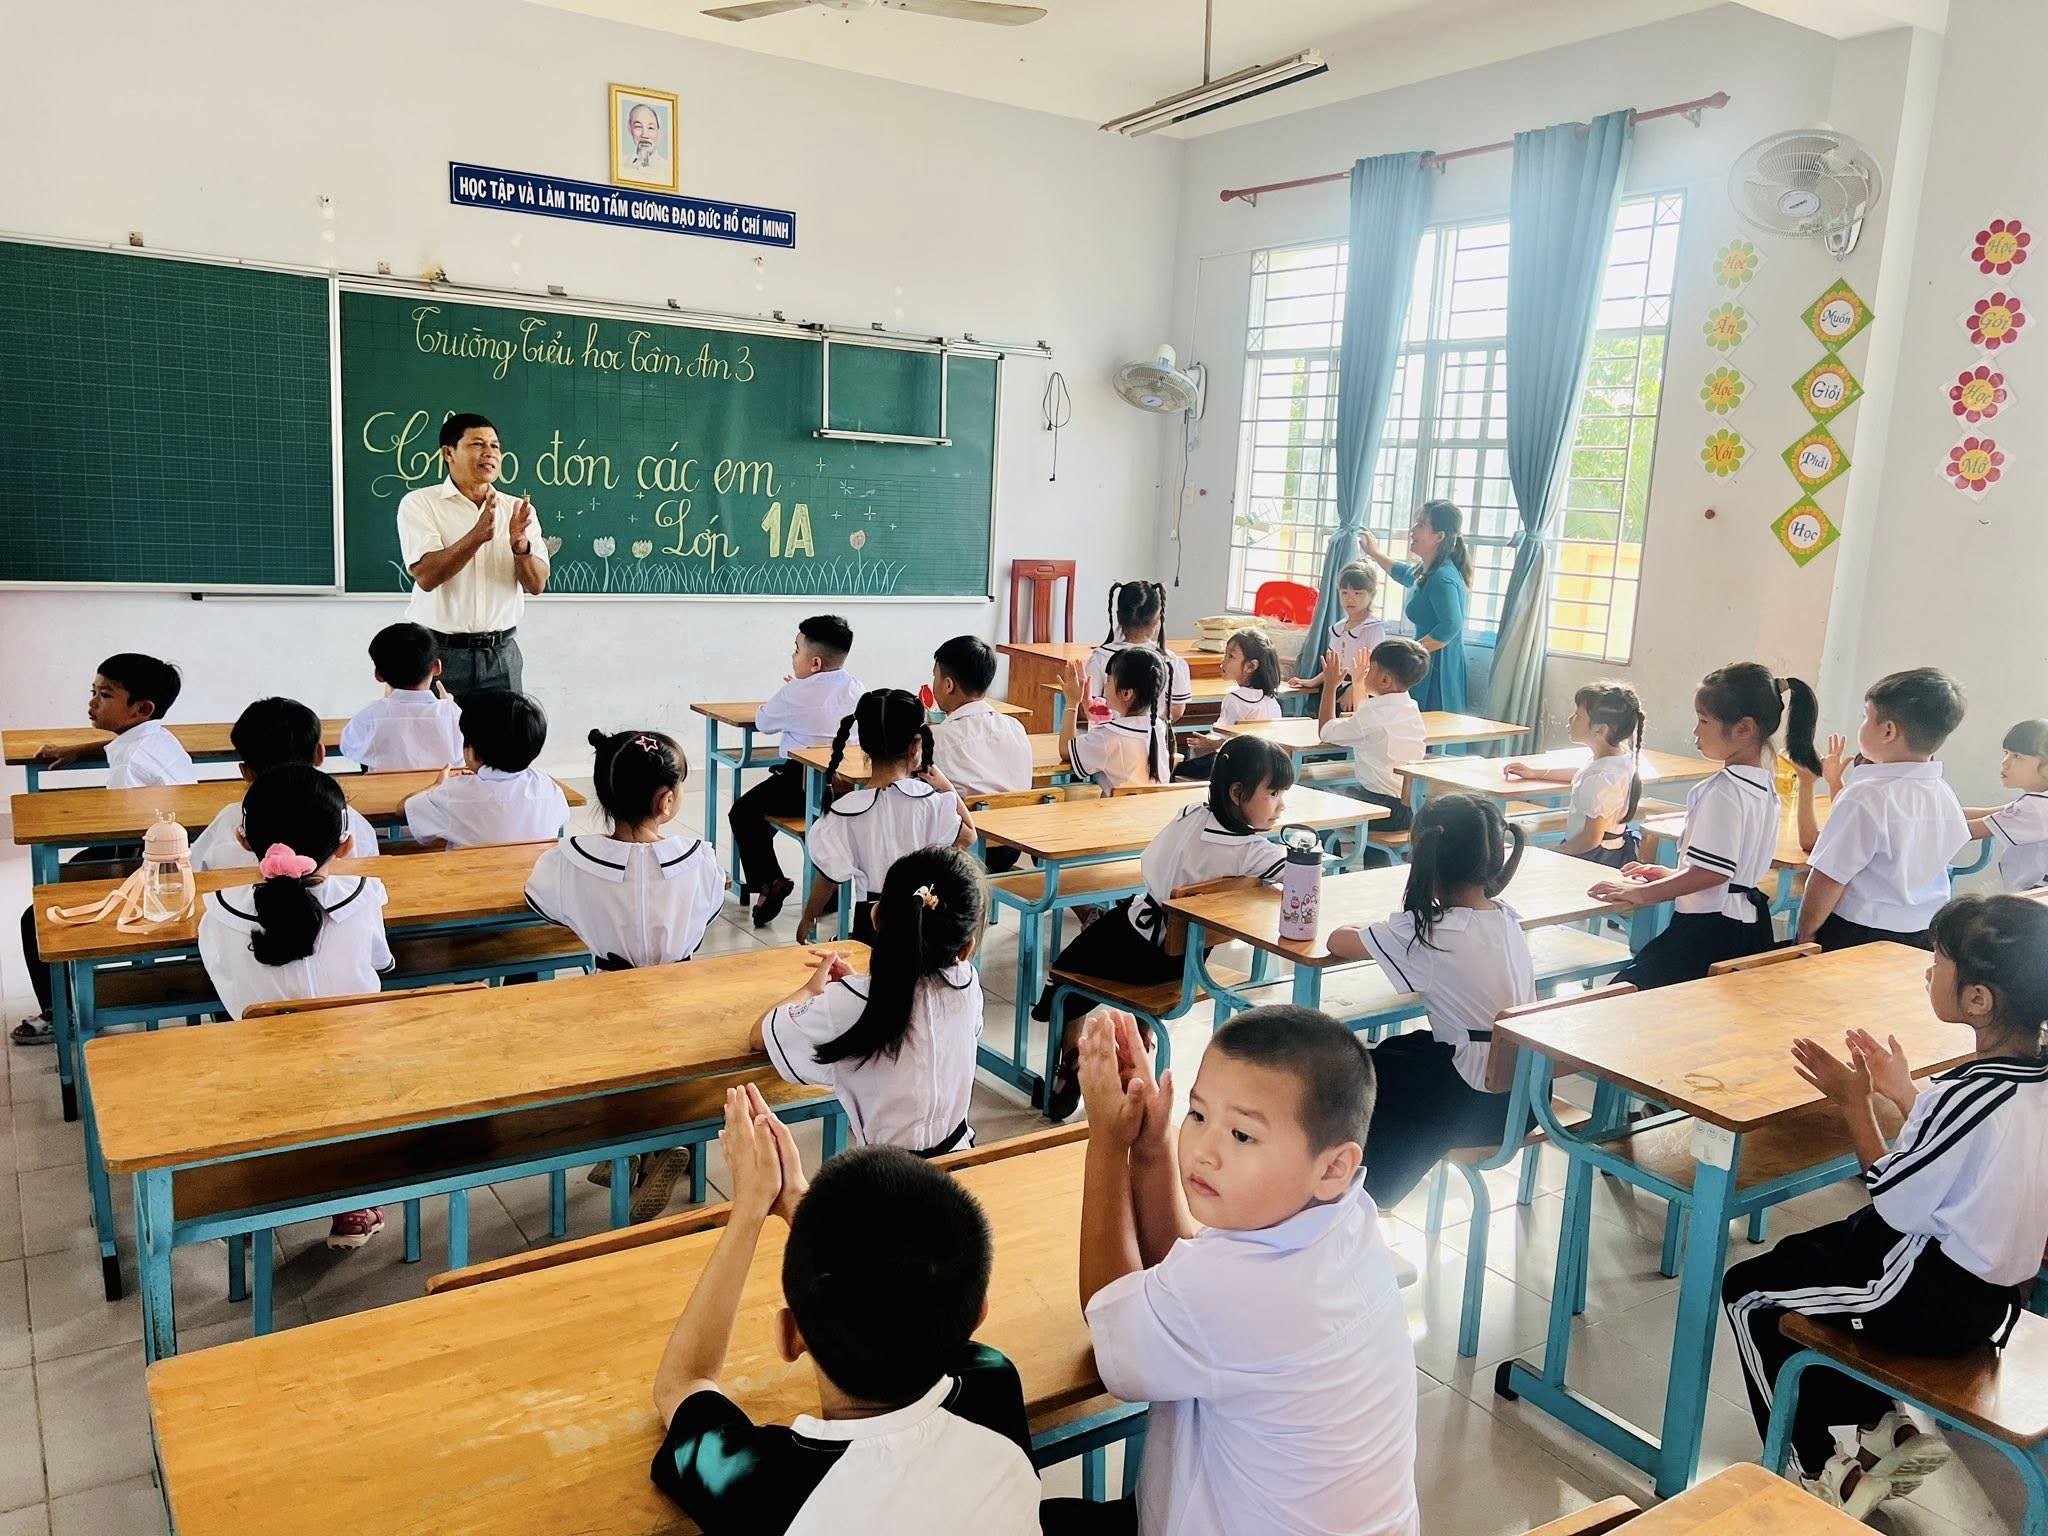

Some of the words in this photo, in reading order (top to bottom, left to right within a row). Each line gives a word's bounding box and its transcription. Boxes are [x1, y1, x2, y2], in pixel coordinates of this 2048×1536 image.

[459, 176, 487, 200] HỌC
[490, 177, 515, 204] TẬP
[518, 180, 535, 205] VÀ
[538, 184, 565, 209] LÀM
[568, 191, 600, 214] THEO
[602, 192, 628, 218] TẤM
[631, 201, 670, 223] GƯƠNG
[672, 207, 695, 228] ĐẠO
[698, 207, 721, 230] ĐỨC
[724, 208, 739, 232] HỒ
[742, 214, 760, 235] CHÍ
[762, 219, 789, 239] MINH
[411, 306, 518, 380] Trường
[520, 317, 575, 366] Tiểu
[581, 322, 625, 374] học
[627, 330, 683, 376] Tân
[687, 342, 732, 380] An
[735, 345, 755, 382] 3
[536, 429, 621, 490] đón
[637, 441, 701, 492] các
[713, 458, 782, 498] em
[655, 498, 740, 574] Lớp
[760, 501, 815, 558] 1A
[1791, 521, 1818, 542] Học
